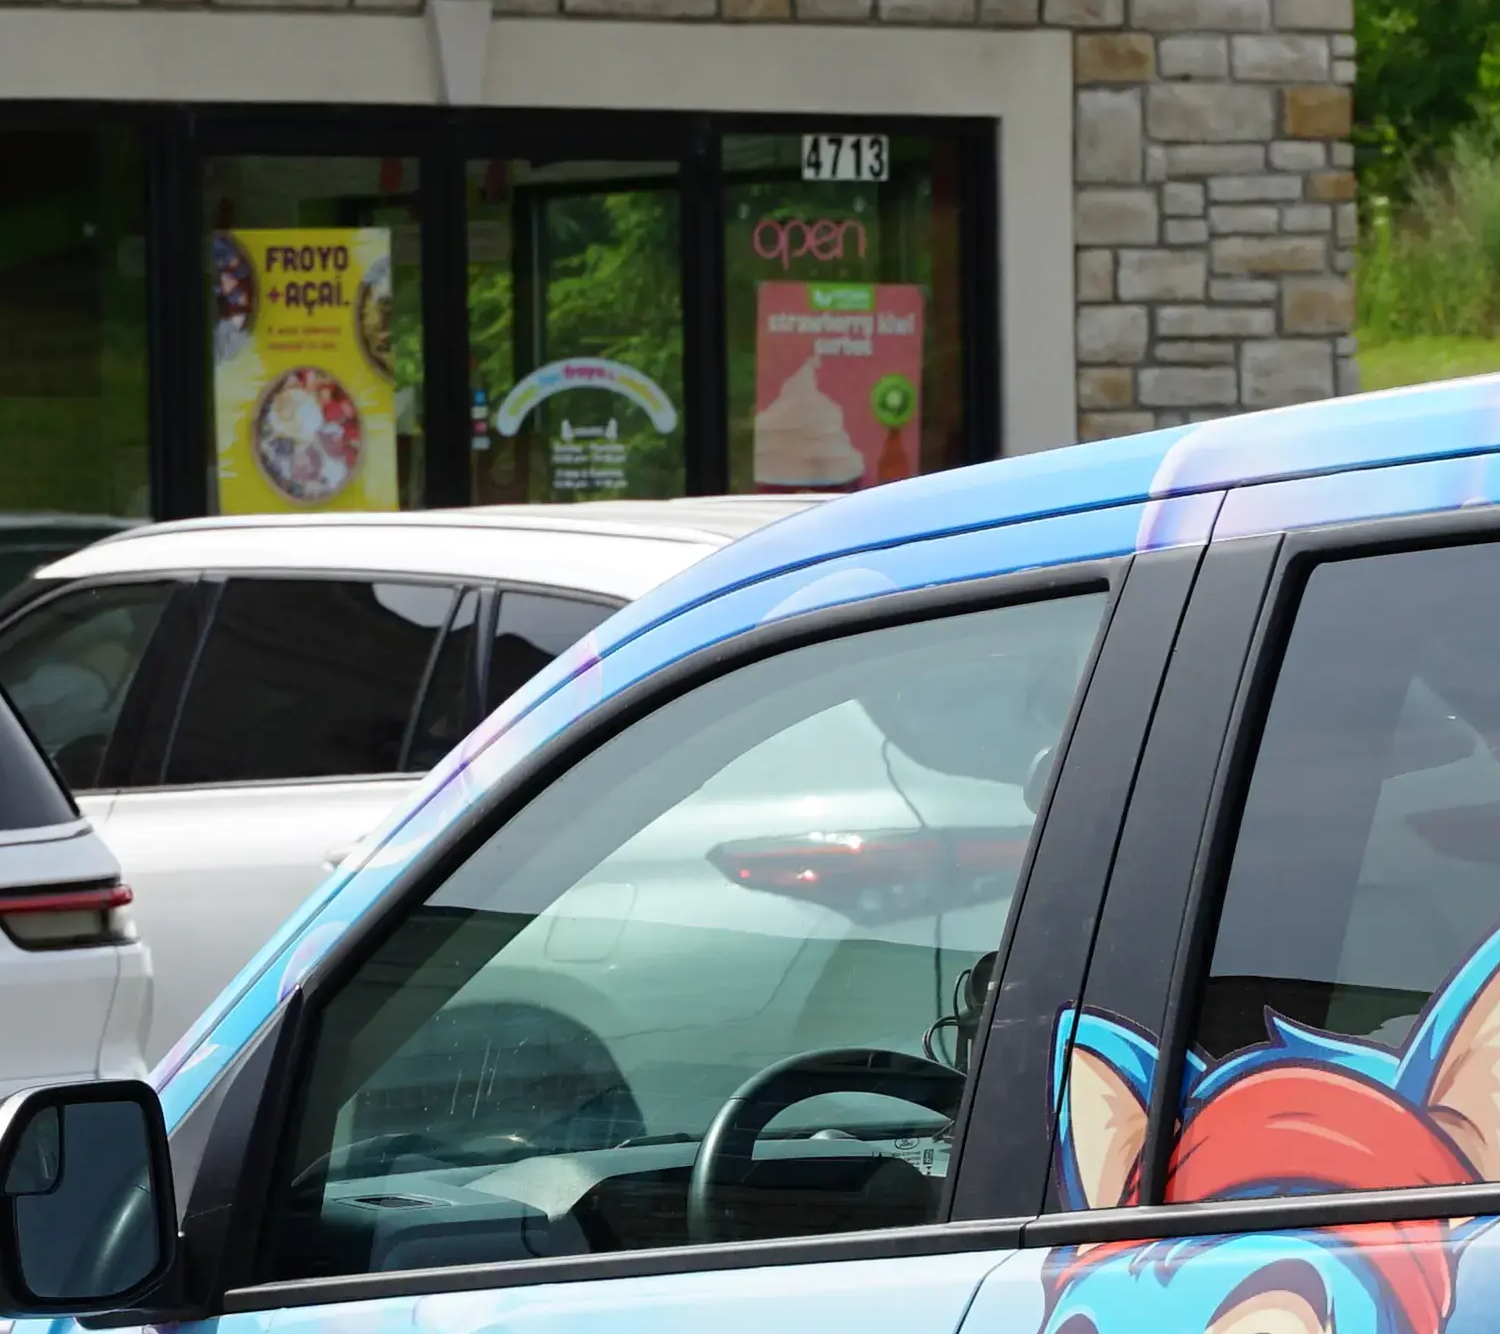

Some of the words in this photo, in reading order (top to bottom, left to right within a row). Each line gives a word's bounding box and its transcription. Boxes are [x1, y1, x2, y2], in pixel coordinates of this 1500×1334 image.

[806, 136, 884, 178] 4713
[265, 245, 348, 272] FROYO
[753, 218, 866, 269] open
